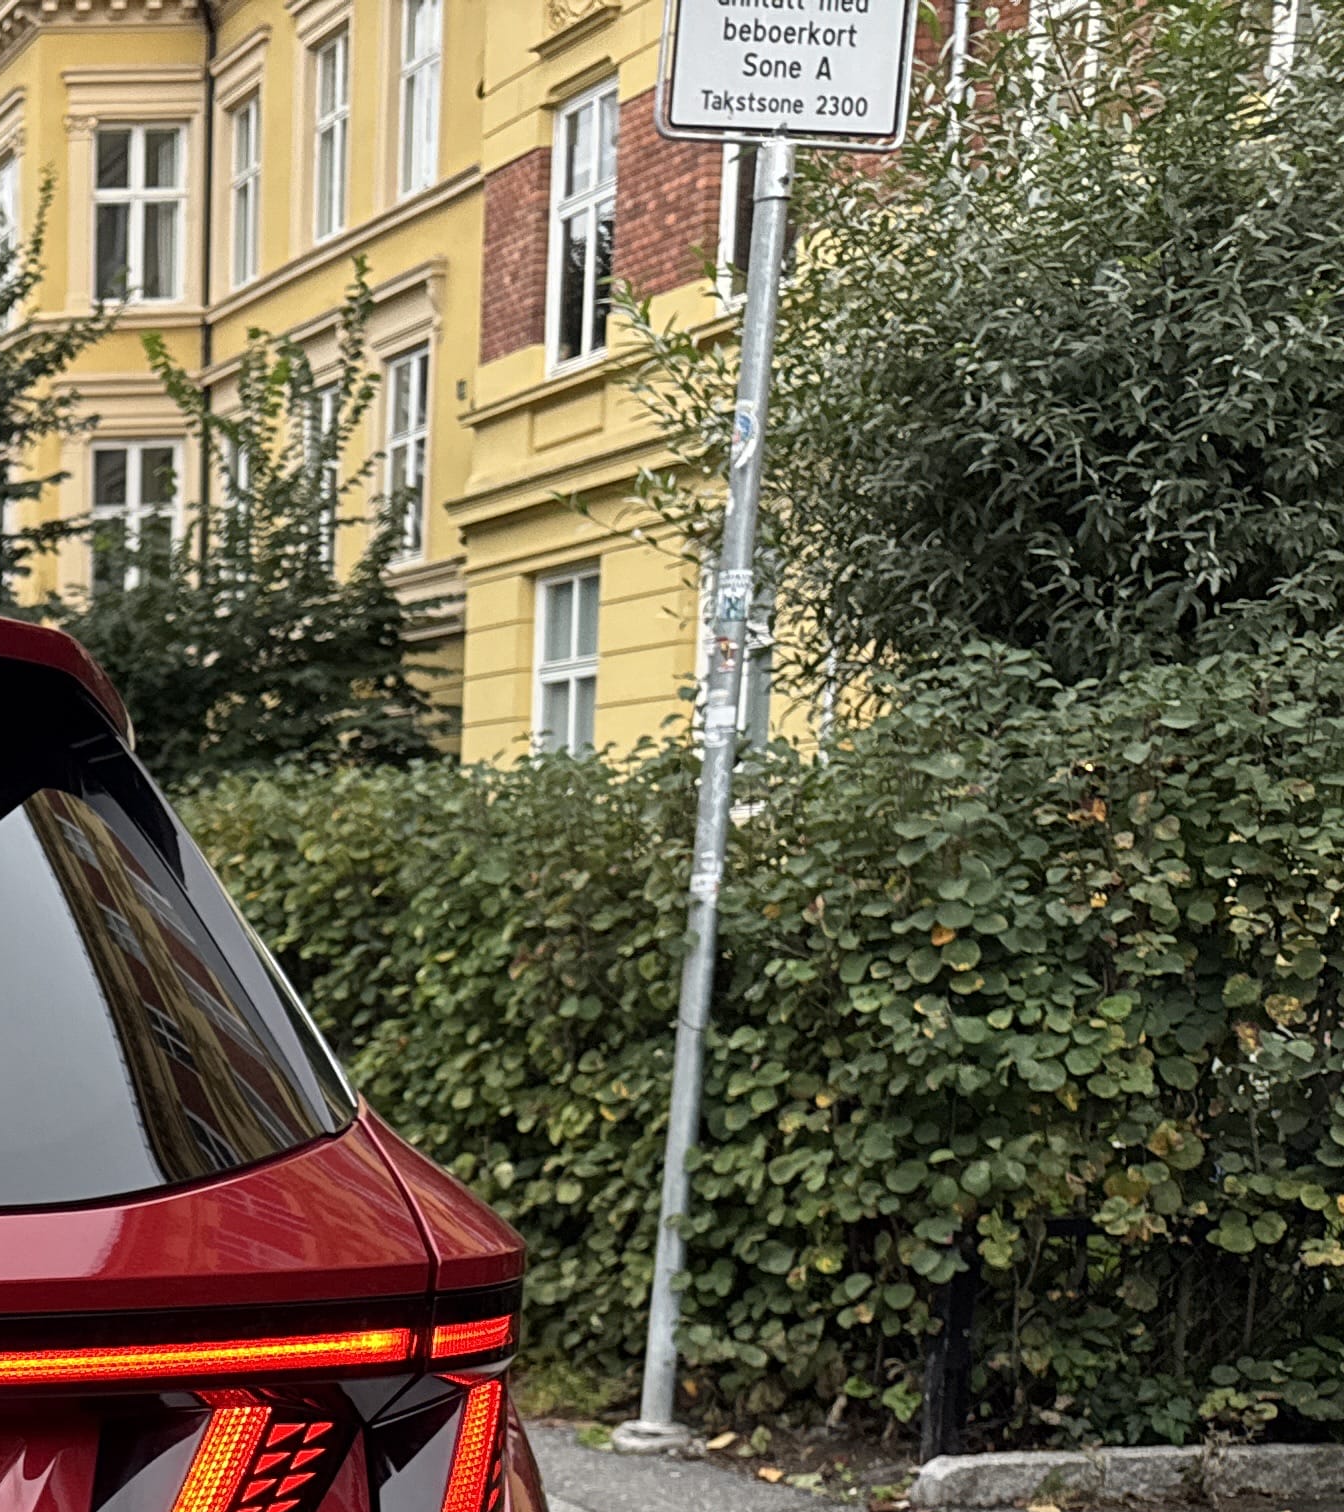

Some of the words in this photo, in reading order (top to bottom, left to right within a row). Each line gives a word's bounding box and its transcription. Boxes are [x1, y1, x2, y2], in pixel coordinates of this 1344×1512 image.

[723, 17, 857, 47] beboerkort
[742, 53, 802, 79] Sone
[815, 56, 833, 81] A
[701, 89, 804, 115] Takstsone
[815, 95, 868, 117] 2300
